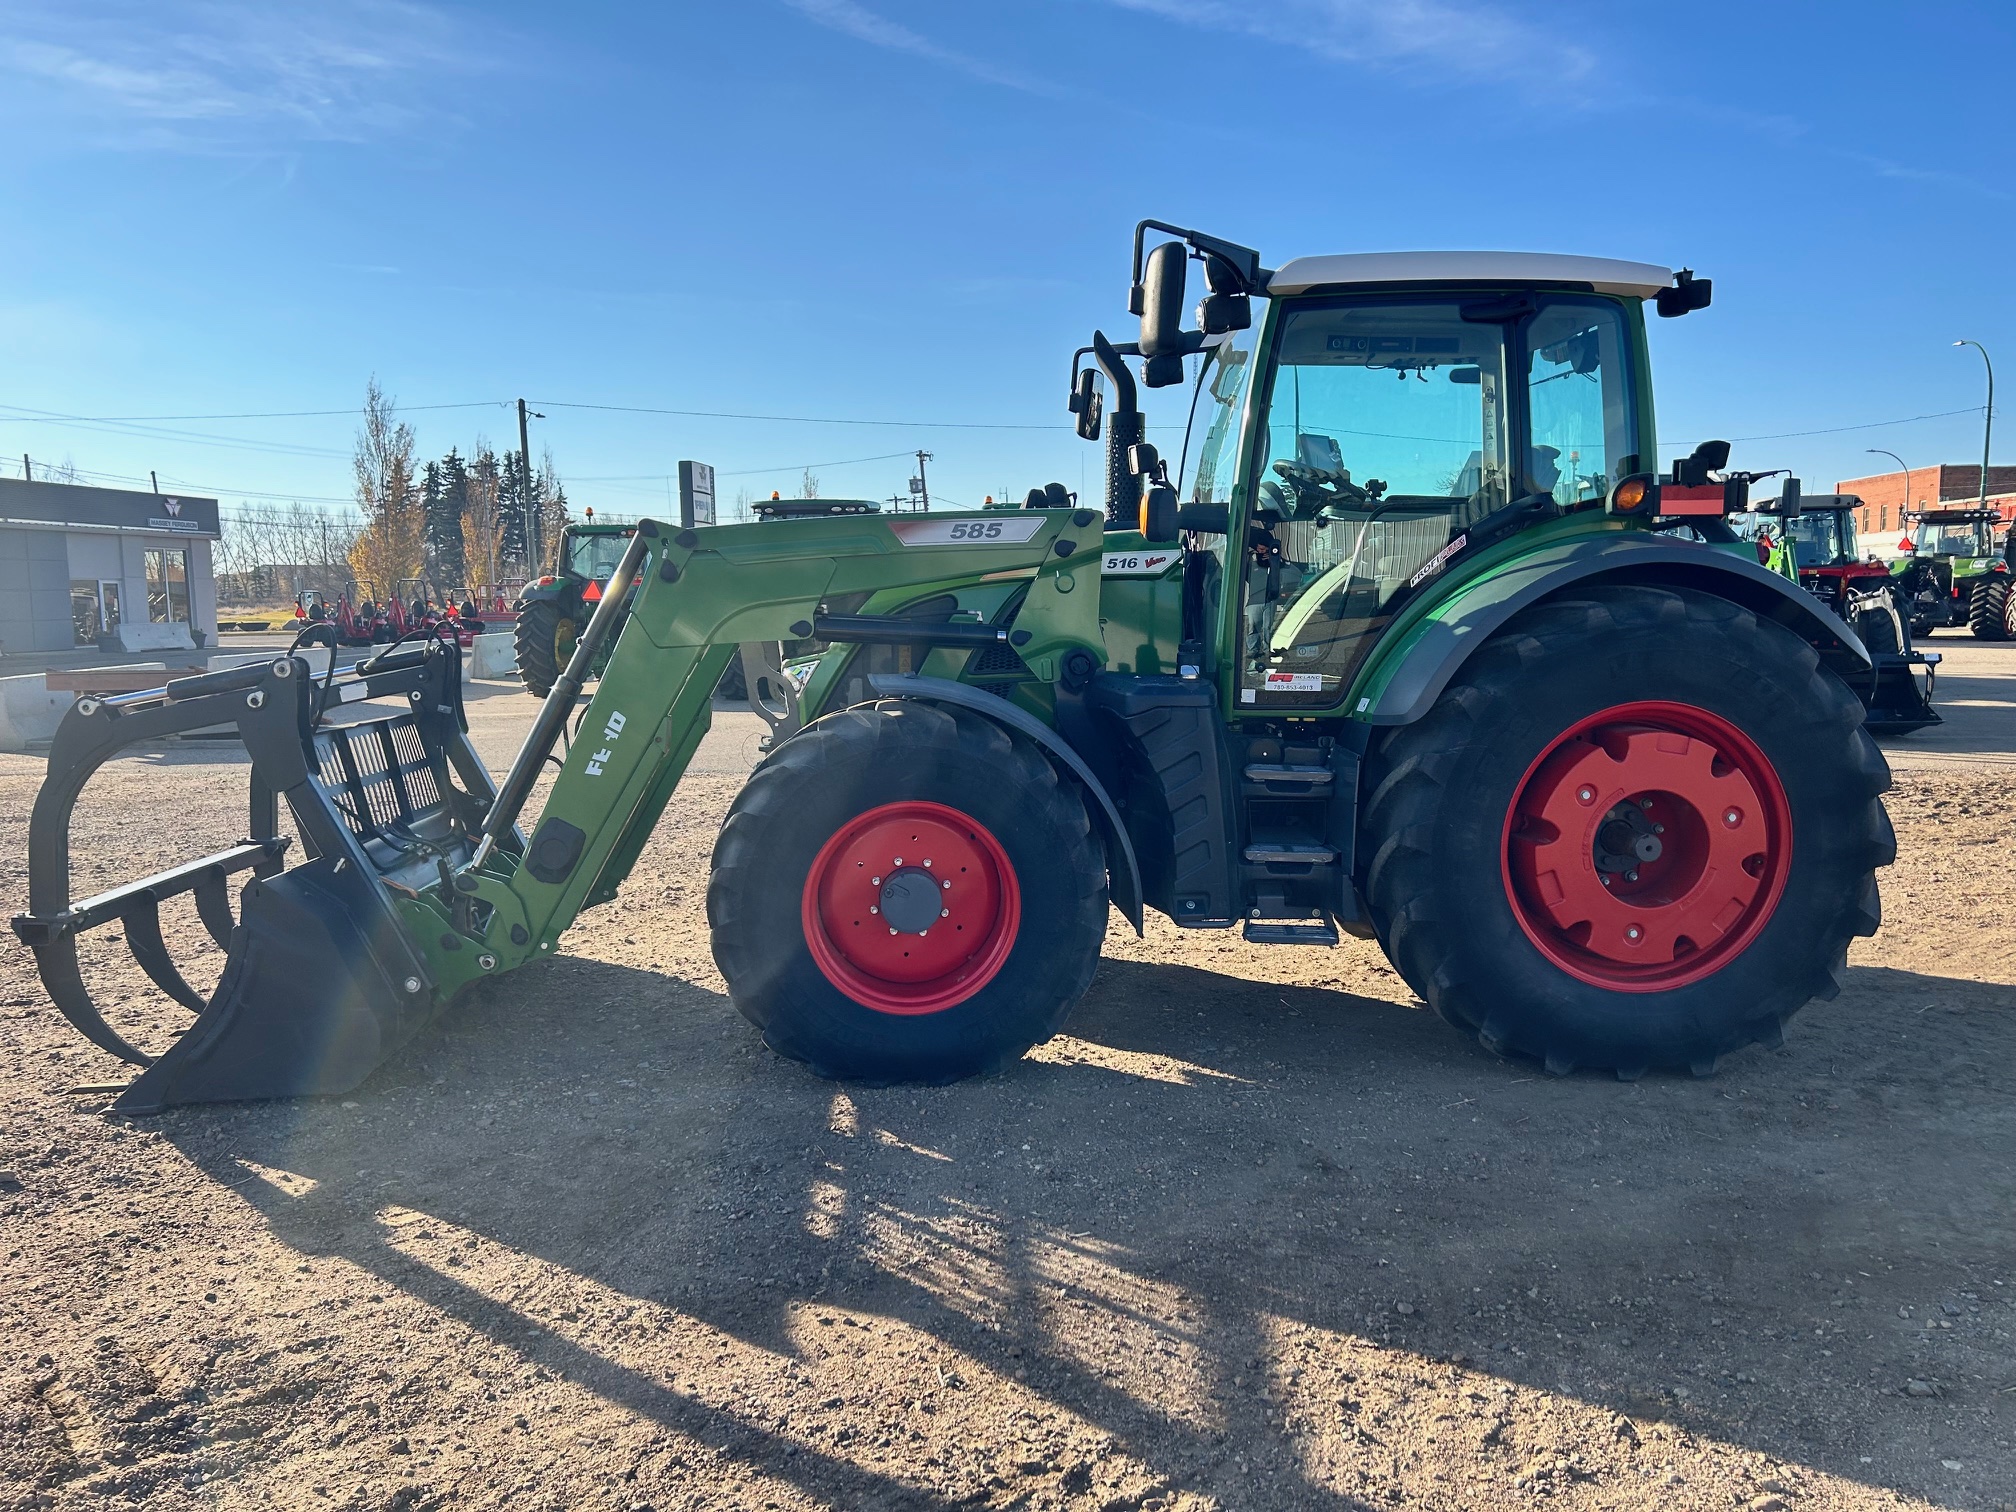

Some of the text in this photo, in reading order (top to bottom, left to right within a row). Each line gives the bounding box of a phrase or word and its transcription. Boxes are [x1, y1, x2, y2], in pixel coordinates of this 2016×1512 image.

[151, 519, 170, 527] MASSEY
[950, 523, 1003, 539] 585
[1107, 557, 1138, 569] 516
